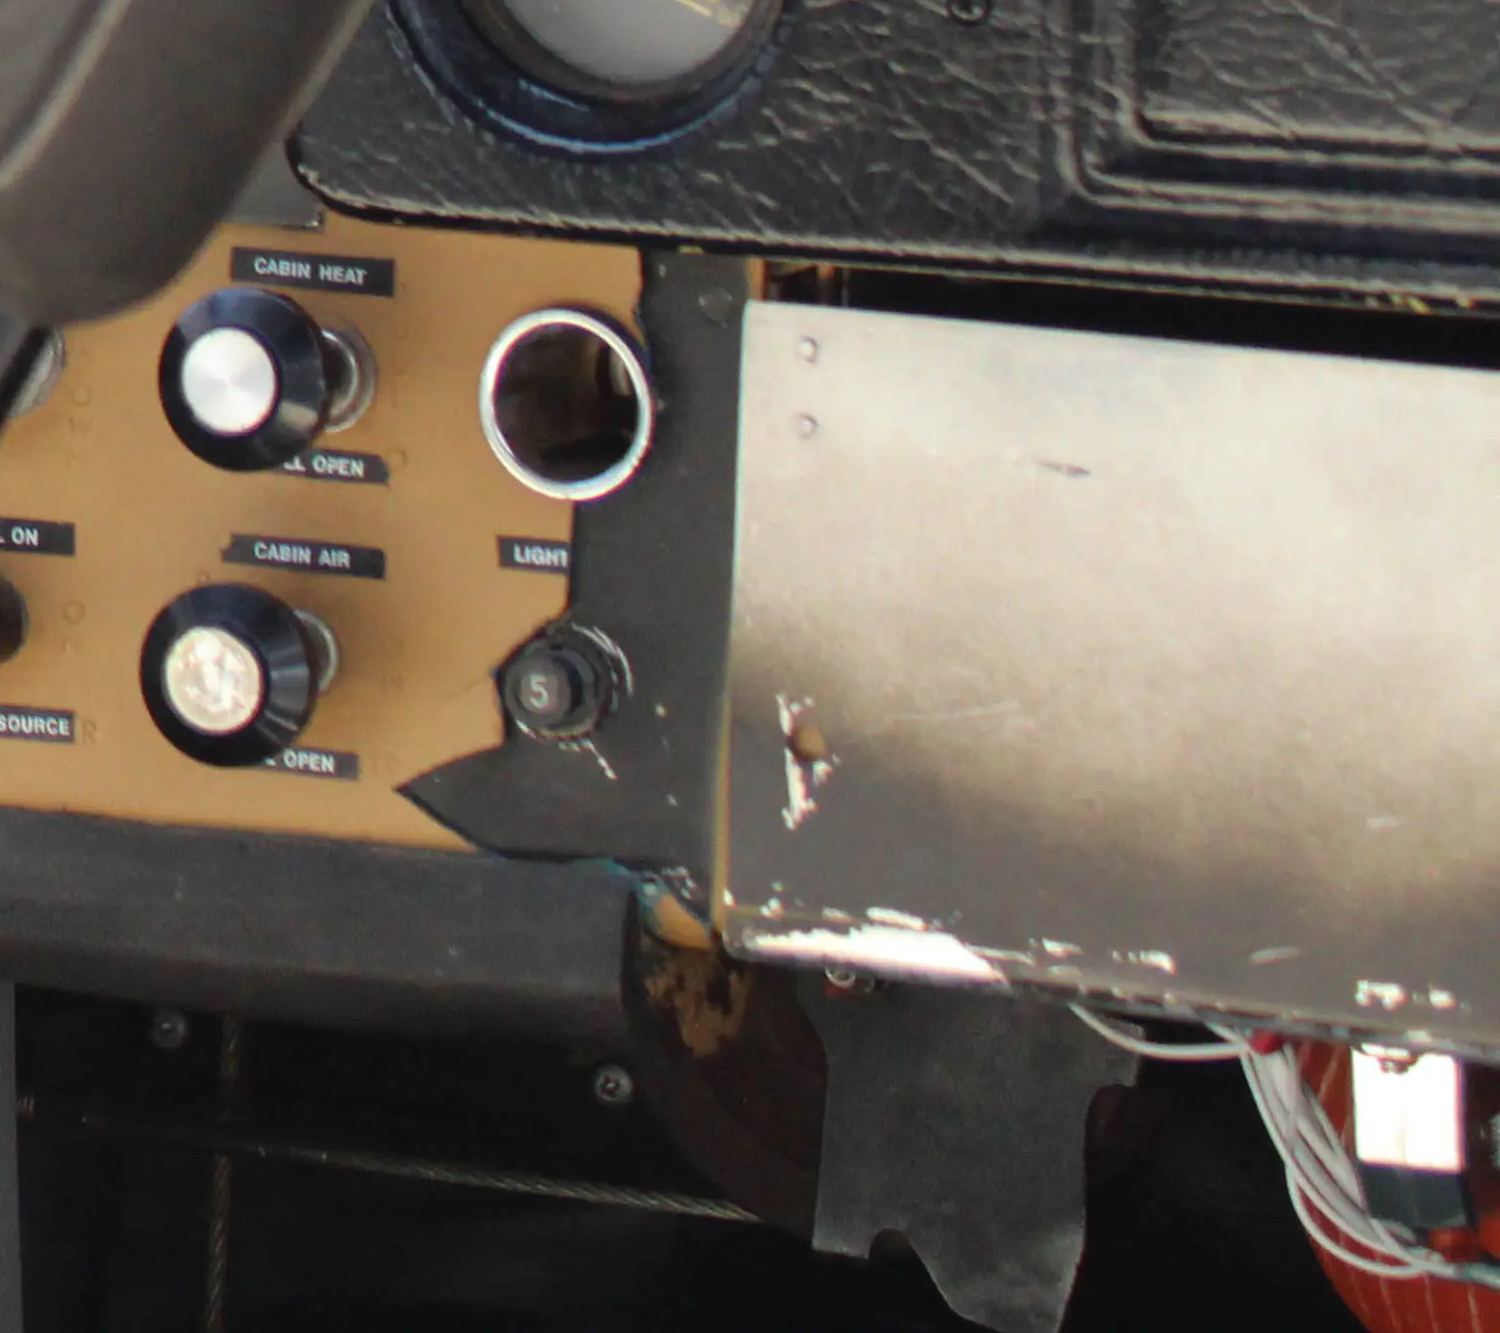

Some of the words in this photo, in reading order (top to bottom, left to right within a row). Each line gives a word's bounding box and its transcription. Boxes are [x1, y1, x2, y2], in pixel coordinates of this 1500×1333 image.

[254, 258, 311, 280] CABIN
[319, 264, 368, 285] HEAT
[312, 456, 365, 478] OPEN
[11, 528, 38, 547] ON
[254, 542, 311, 565] CABIN
[318, 548, 351, 569] AIR
[513, 545, 567, 568] LIGHT
[283, 750, 336, 773] OPEN
